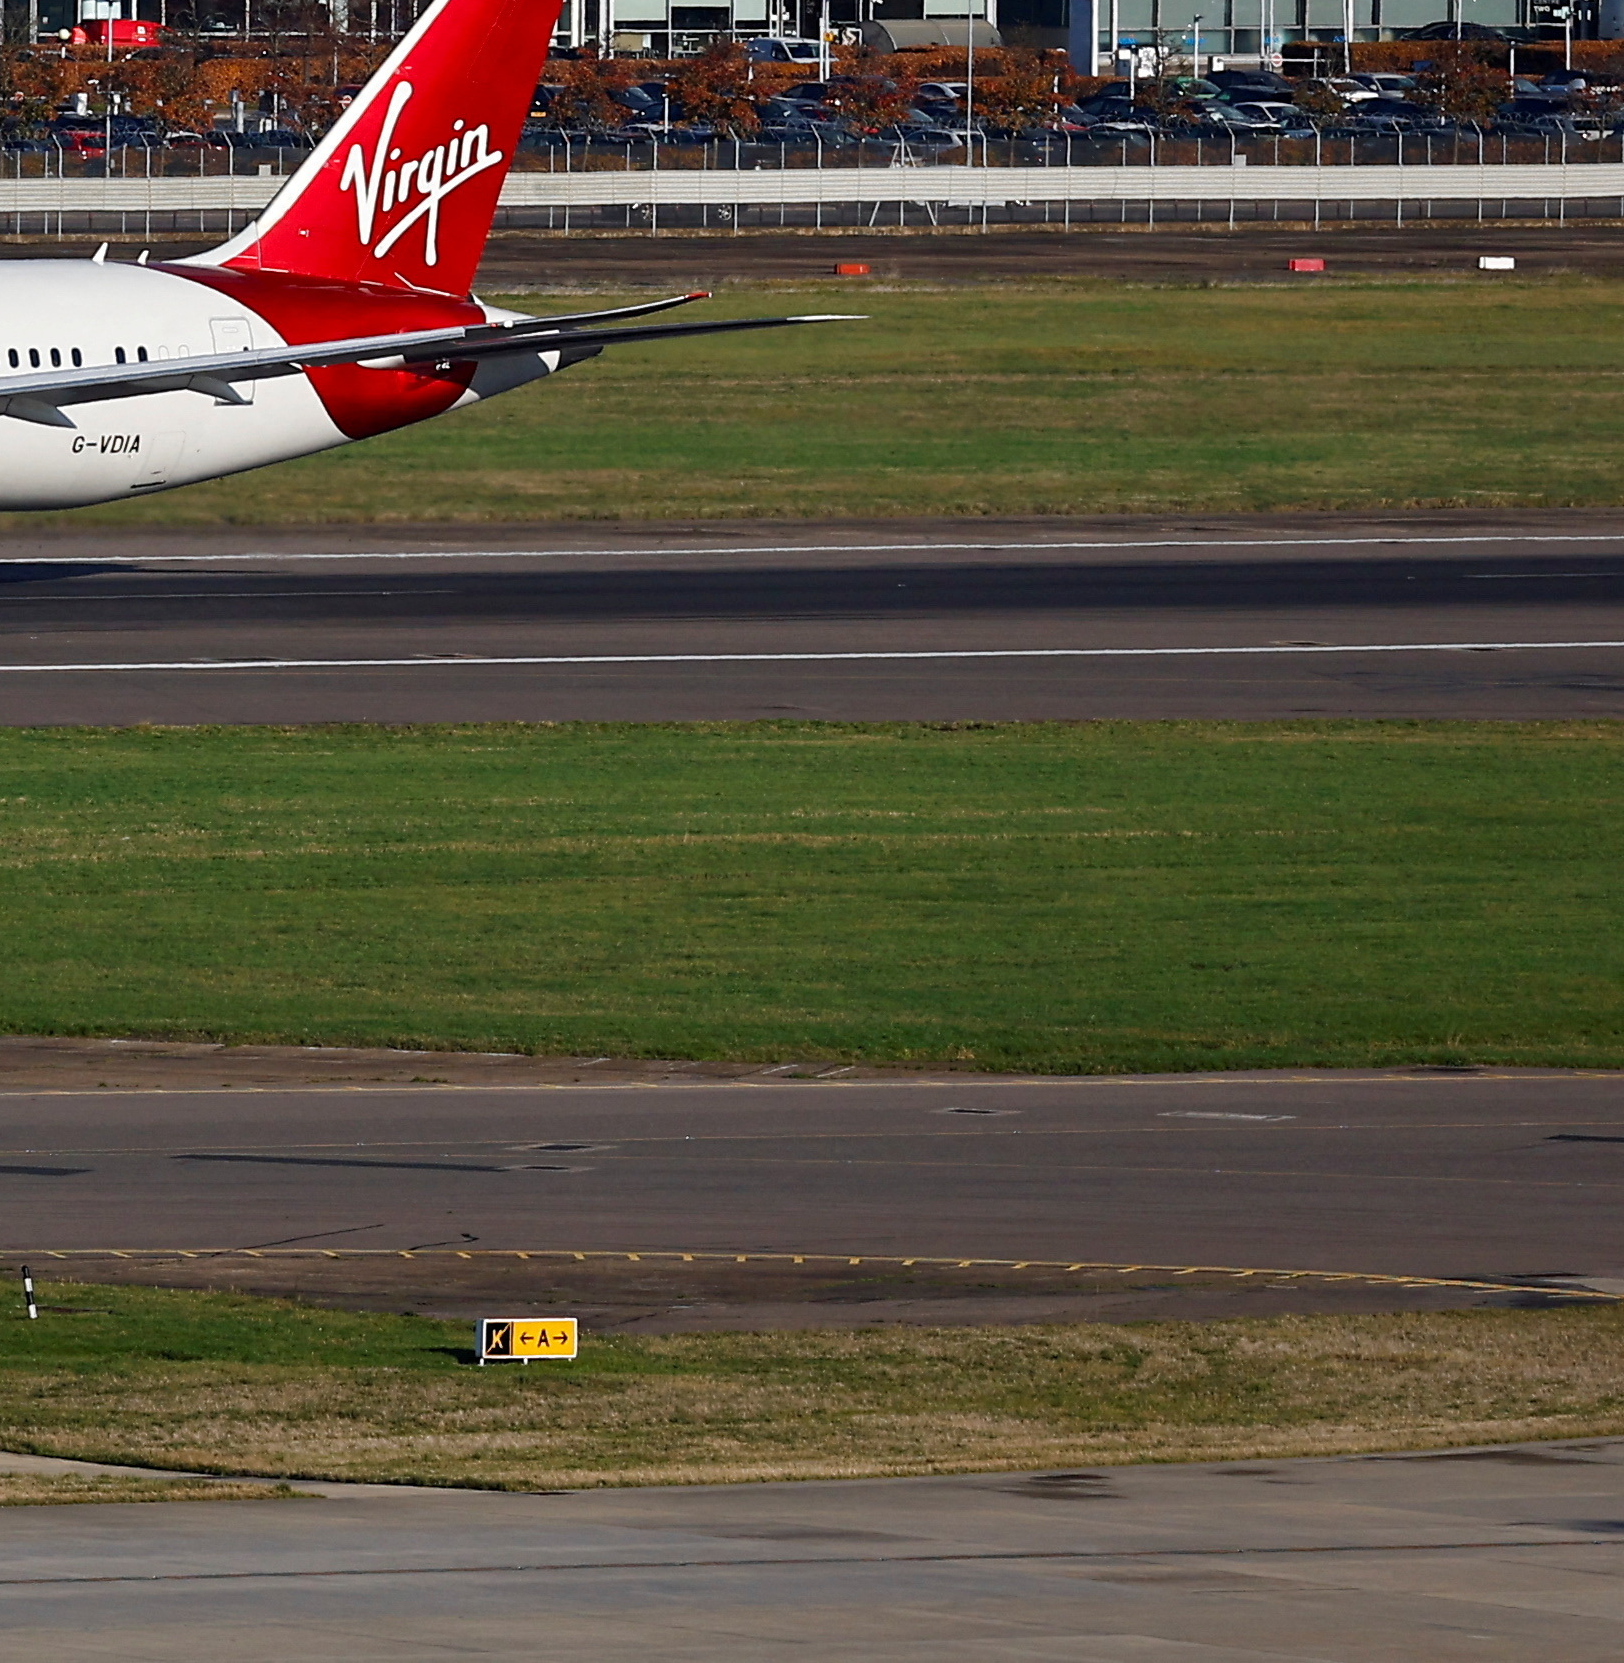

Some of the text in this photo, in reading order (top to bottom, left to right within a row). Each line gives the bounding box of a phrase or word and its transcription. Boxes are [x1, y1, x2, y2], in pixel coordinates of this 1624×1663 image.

[340, 81, 502, 266] Virgin
[71, 434, 140, 454] G-VDIA
[492, 1329, 503, 1349] K
[537, 1328, 550, 1348] A
